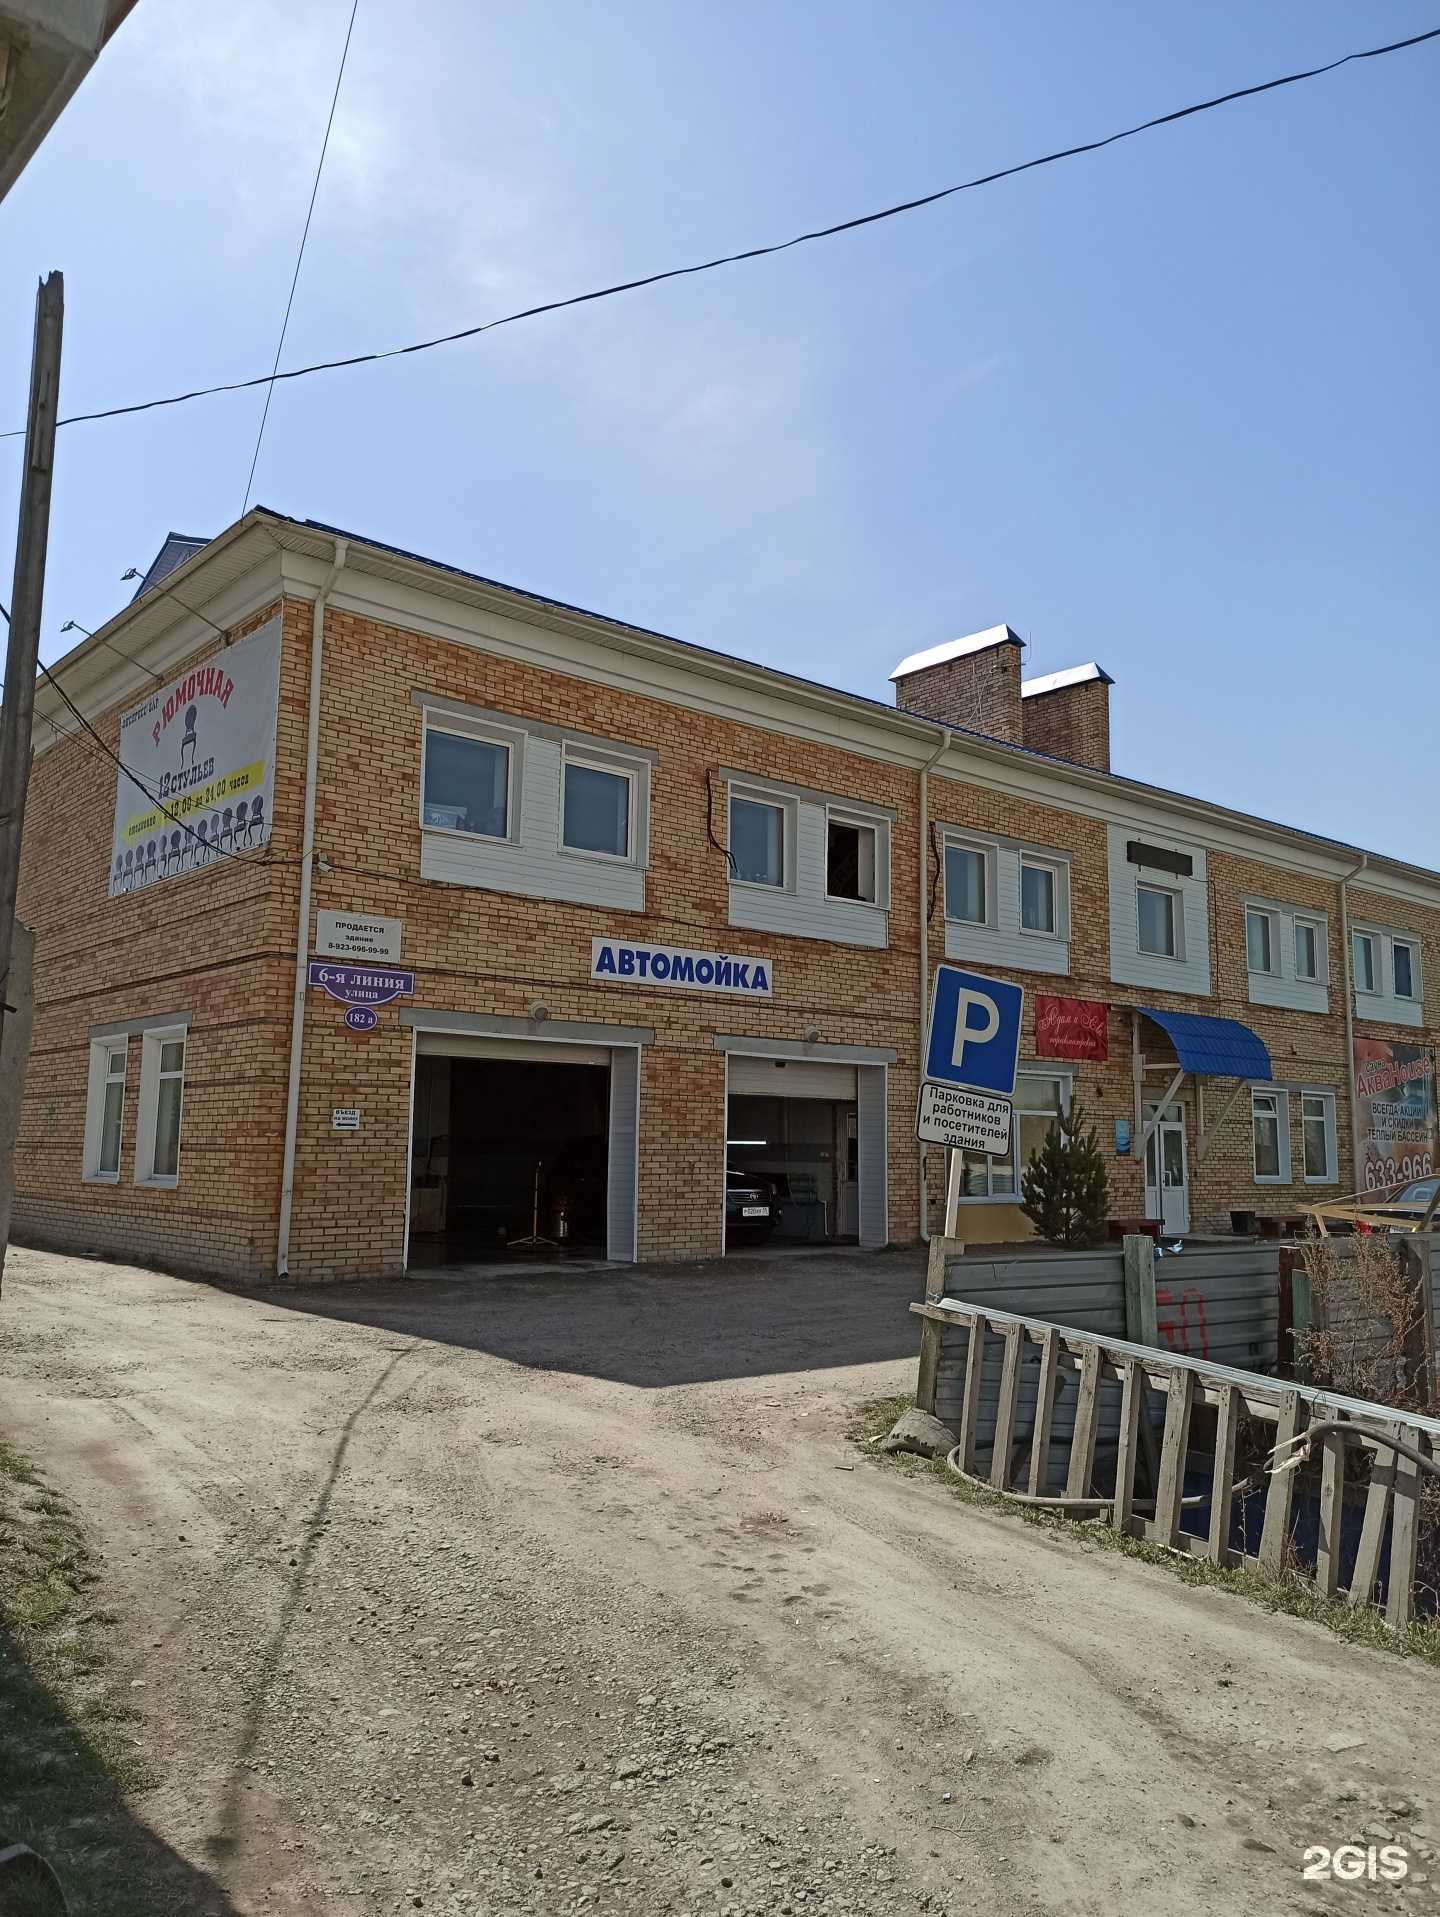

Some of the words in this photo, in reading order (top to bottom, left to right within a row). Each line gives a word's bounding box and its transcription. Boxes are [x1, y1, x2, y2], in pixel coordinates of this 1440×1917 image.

[152, 667, 234, 748] РЮМОЧНАЯ
[335, 921, 385, 934] ПРОДАЕТСЯ
[595, 946, 768, 991] АВТОМОЙКА
[345, 989, 378, 999] улица
[349, 1013, 366, 1024] 182
[929, 1086, 984, 1109] Парковка
[987, 1101, 1009, 1114] для
[1372, 1102, 1398, 1116] ВСЕГДА
[932, 1103, 1001, 1126] работников
[1389, 1118, 1414, 1130] СКИДКИ
[923, 1115, 931, 1125] и
[933, 1117, 1008, 1140] посетителей
[943, 1133, 985, 1149] здания
[1365, 1152, 1433, 1191] 633-966
